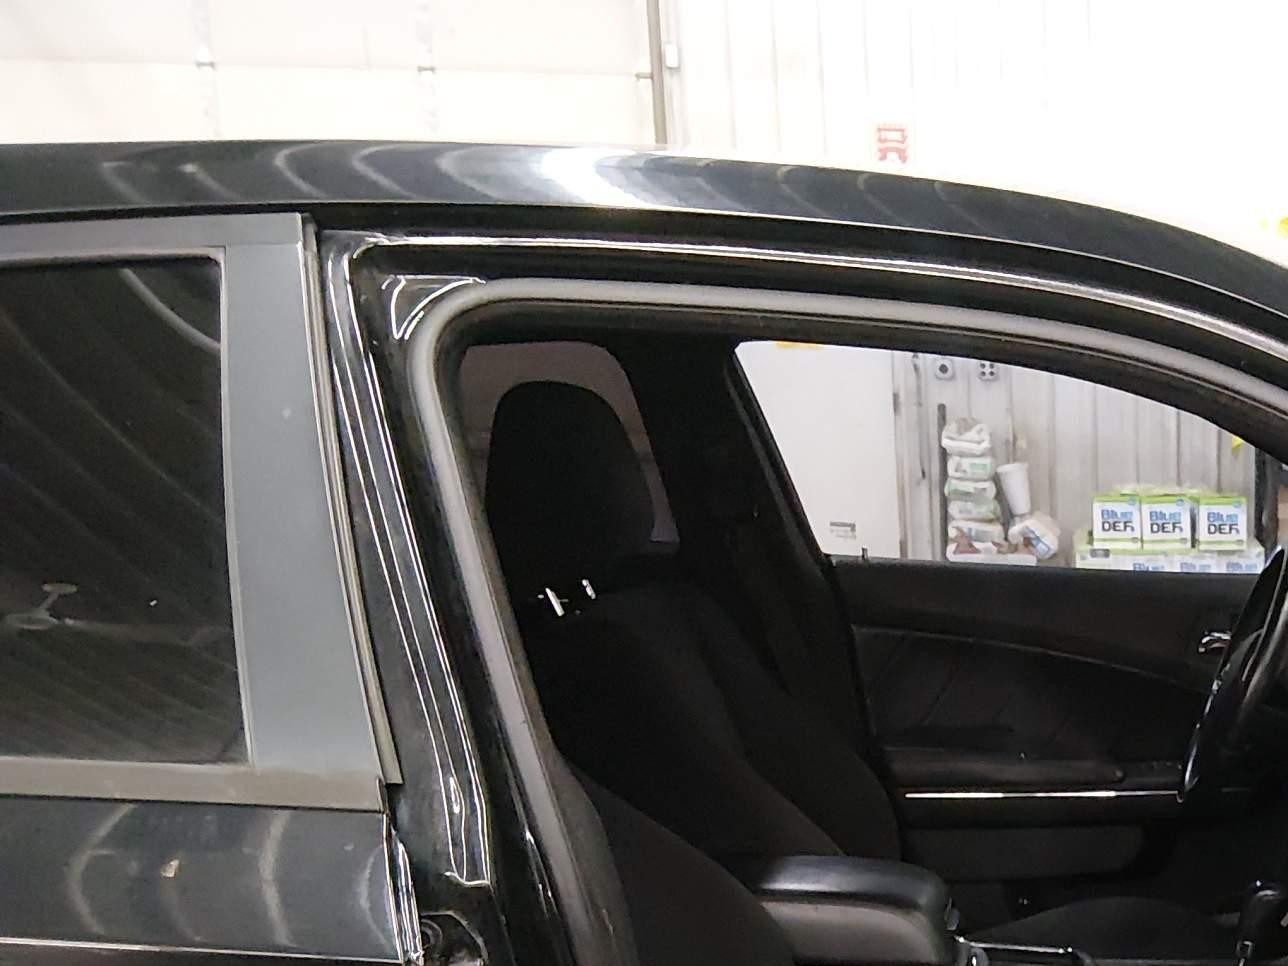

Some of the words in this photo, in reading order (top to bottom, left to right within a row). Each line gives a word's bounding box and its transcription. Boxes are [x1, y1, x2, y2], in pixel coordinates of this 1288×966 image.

[1101, 509, 1133, 521] Blue
[1149, 511, 1182, 522] Blue
[1207, 511, 1239, 523] Blue
[1101, 521, 1135, 532] DEF
[1150, 522, 1183, 534] DEF
[1207, 523, 1240, 535] DEF
